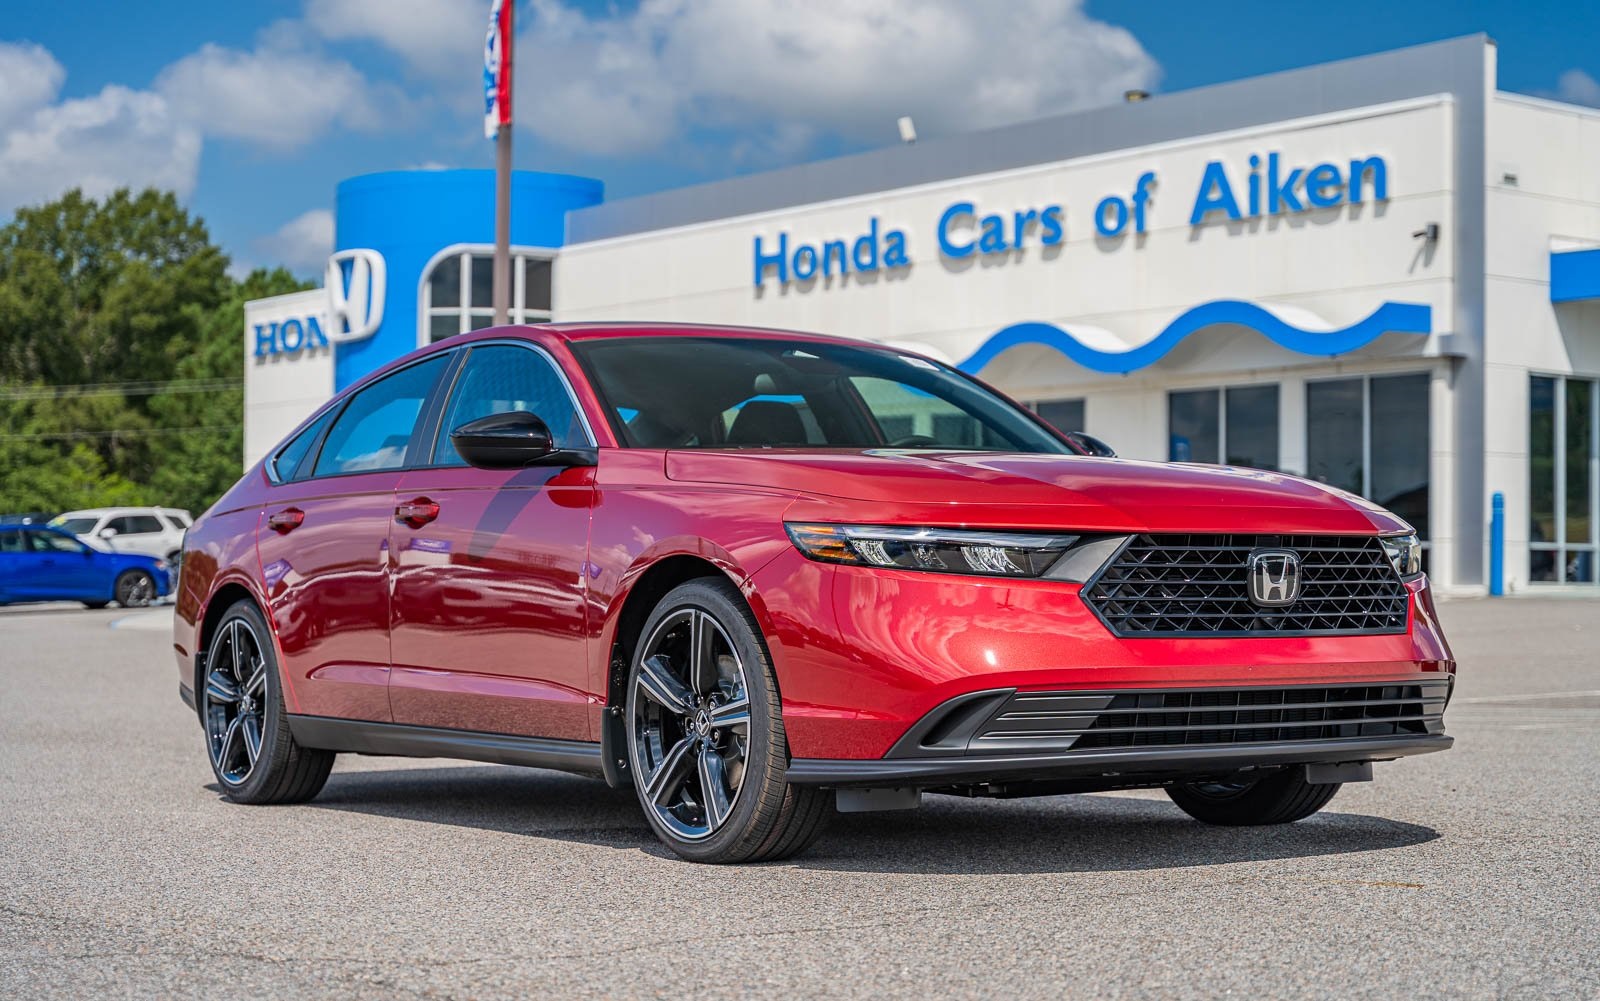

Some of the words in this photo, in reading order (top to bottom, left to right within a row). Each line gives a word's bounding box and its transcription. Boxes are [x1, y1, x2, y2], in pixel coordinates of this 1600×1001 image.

[753, 217, 909, 287] Honda
[937, 202, 1063, 259] Cars
[1093, 171, 1157, 238] of
[1189, 151, 1388, 226] Aiken
